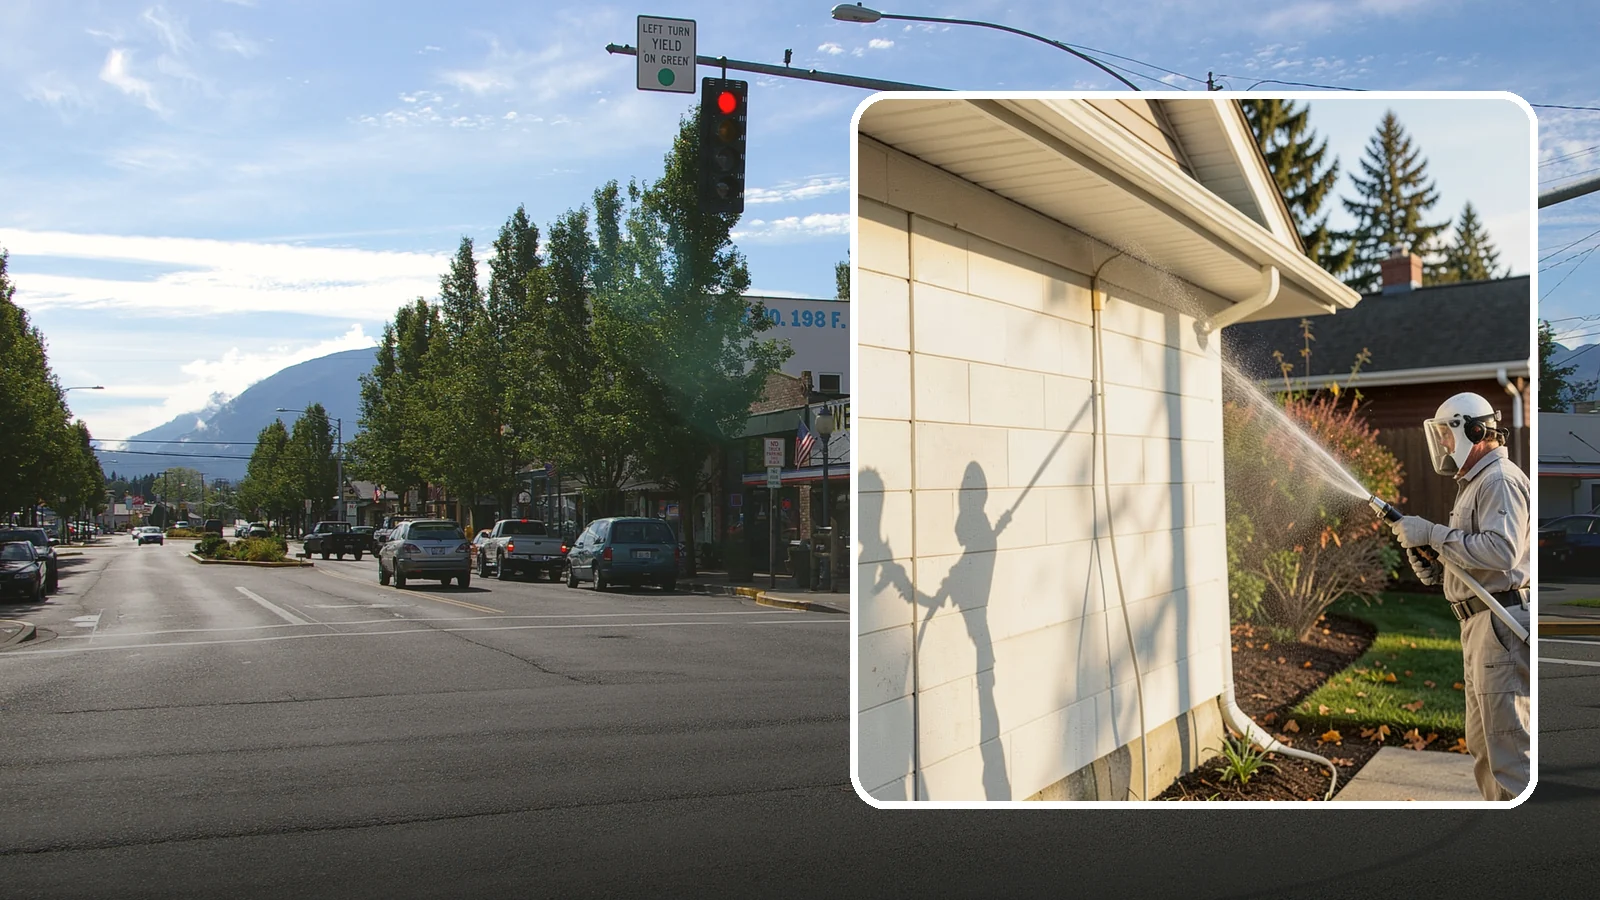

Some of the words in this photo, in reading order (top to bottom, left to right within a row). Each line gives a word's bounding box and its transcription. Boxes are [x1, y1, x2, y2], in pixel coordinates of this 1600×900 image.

[643, 24, 663, 34] LEFT
[668, 26, 690, 36] TURN
[652, 38, 681, 51] YIELD
[791, 309, 826, 328] 198
[831, 311, 846, 329] F.
